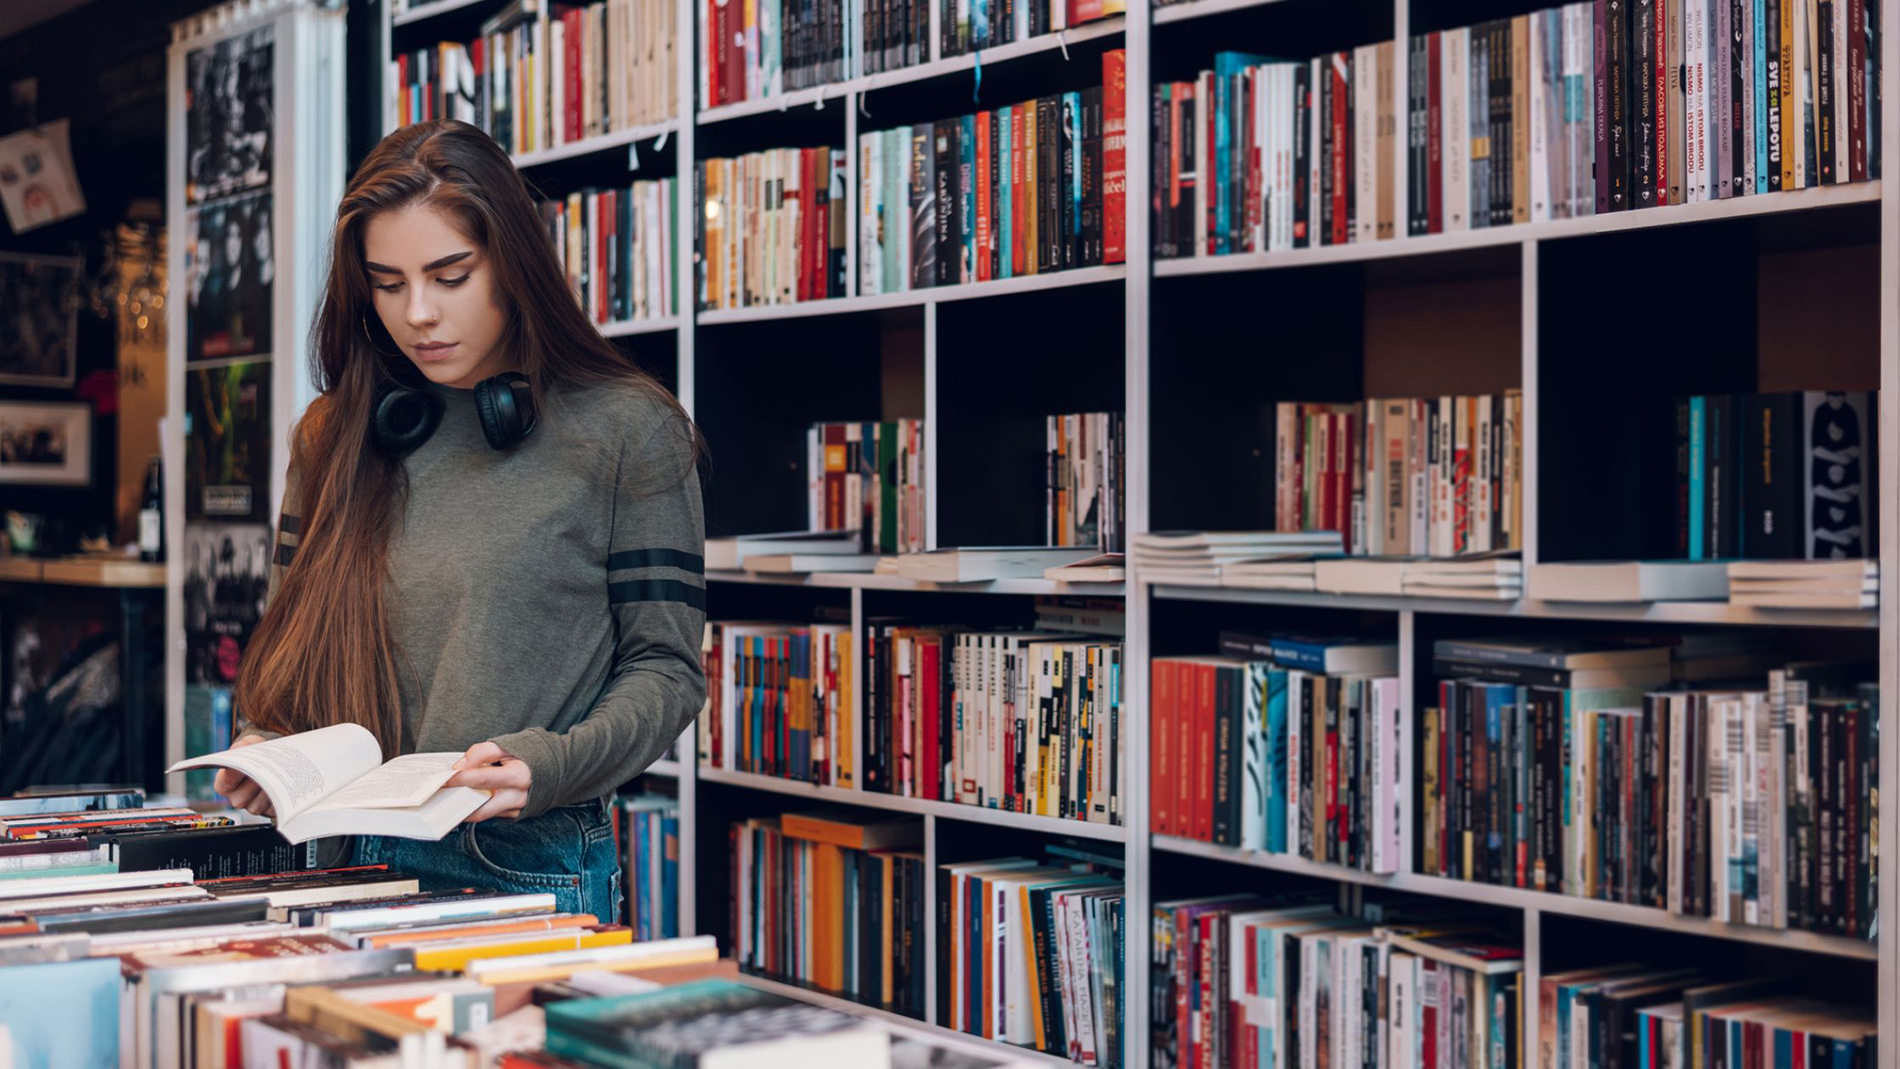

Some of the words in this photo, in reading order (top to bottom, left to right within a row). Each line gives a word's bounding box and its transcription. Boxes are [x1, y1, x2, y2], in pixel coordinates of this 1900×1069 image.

[1769, 61, 1779, 89] SVE
[1783, 44, 1791, 98] ФРАКТУРА
[1687, 97, 1693, 111] NA
[1697, 94, 1703, 107] NA
[1770, 90, 1778, 107] za
[1000, 116, 1009, 150] Irving
[1013, 114, 1021, 149] Irving
[1025, 112, 1034, 147] Irving
[1658, 117, 1665, 129] ИЗ
[1770, 107, 1780, 162] LEPOTU
[913, 134, 927, 193] Jadnici
[1643, 175, 1649, 184] 2
[938, 171, 948, 242] KARENJINA
[1072, 910, 1085, 980] KATARINA
[1080, 986, 1091, 1036] MAZETI
